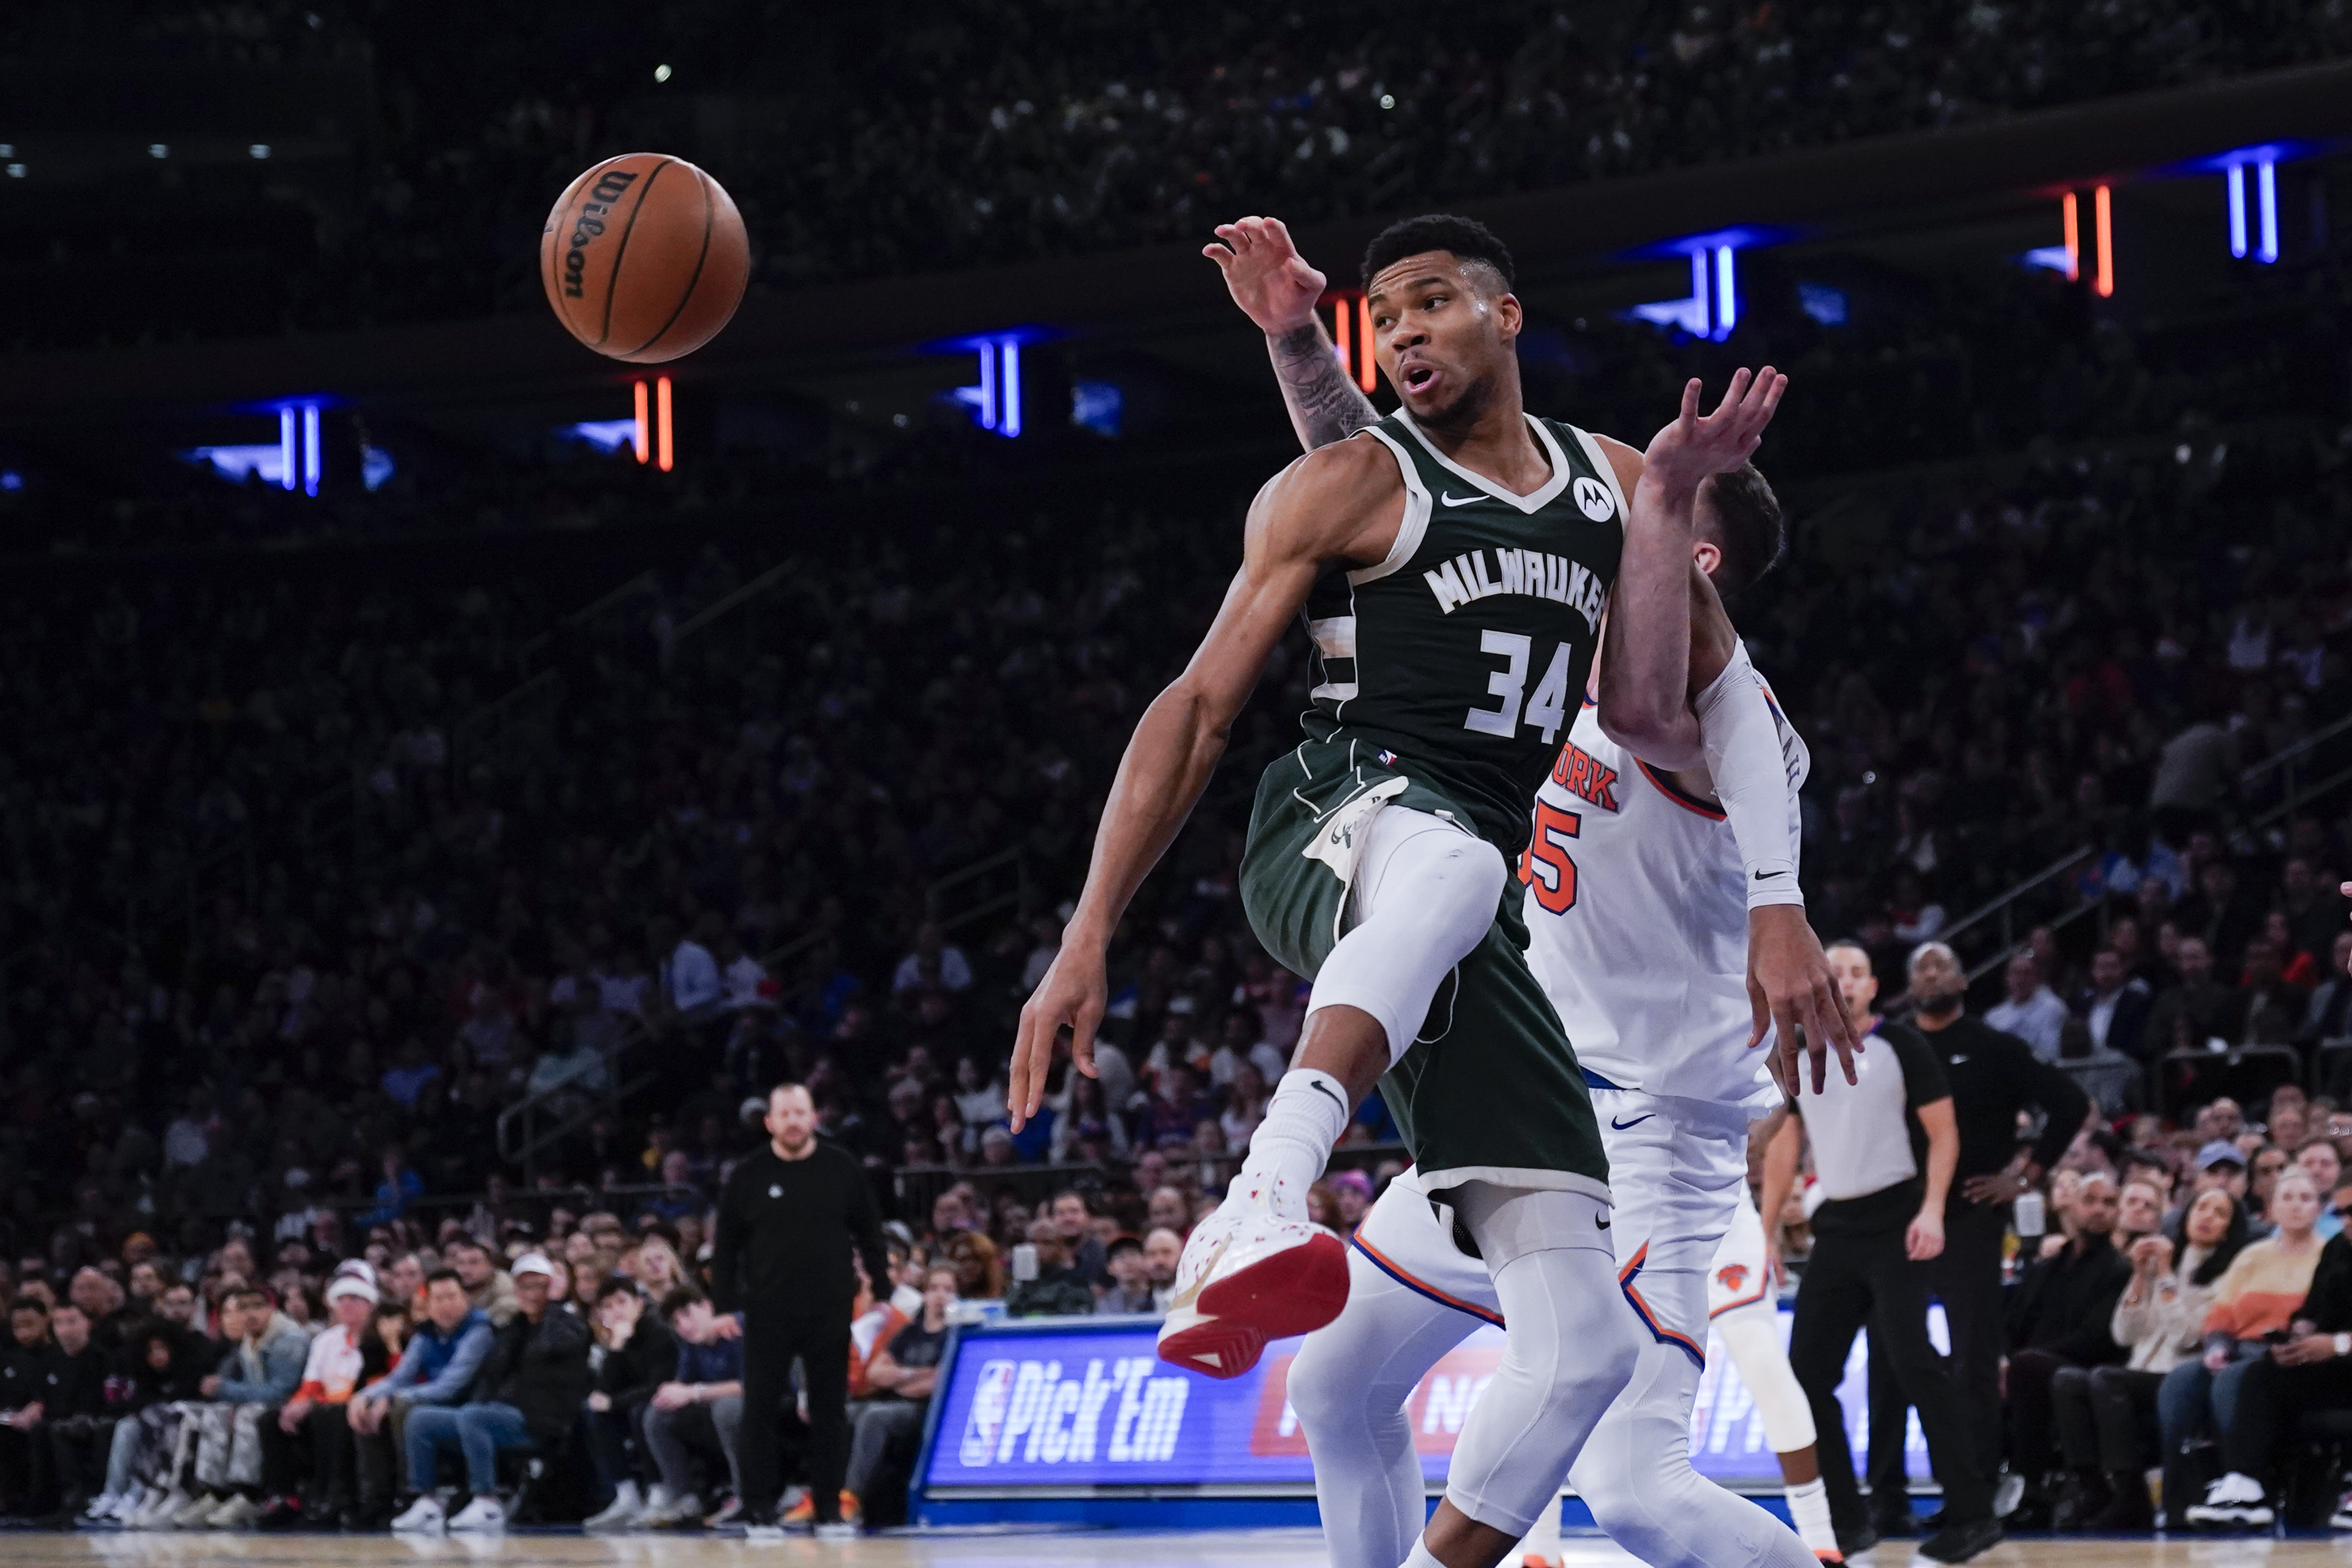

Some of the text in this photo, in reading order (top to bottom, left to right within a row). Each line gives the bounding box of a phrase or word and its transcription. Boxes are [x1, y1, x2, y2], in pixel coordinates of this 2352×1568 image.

[566, 171, 639, 299] Wilson
[1464, 629, 1572, 745] 34
[1552, 741, 1619, 814] ORK
